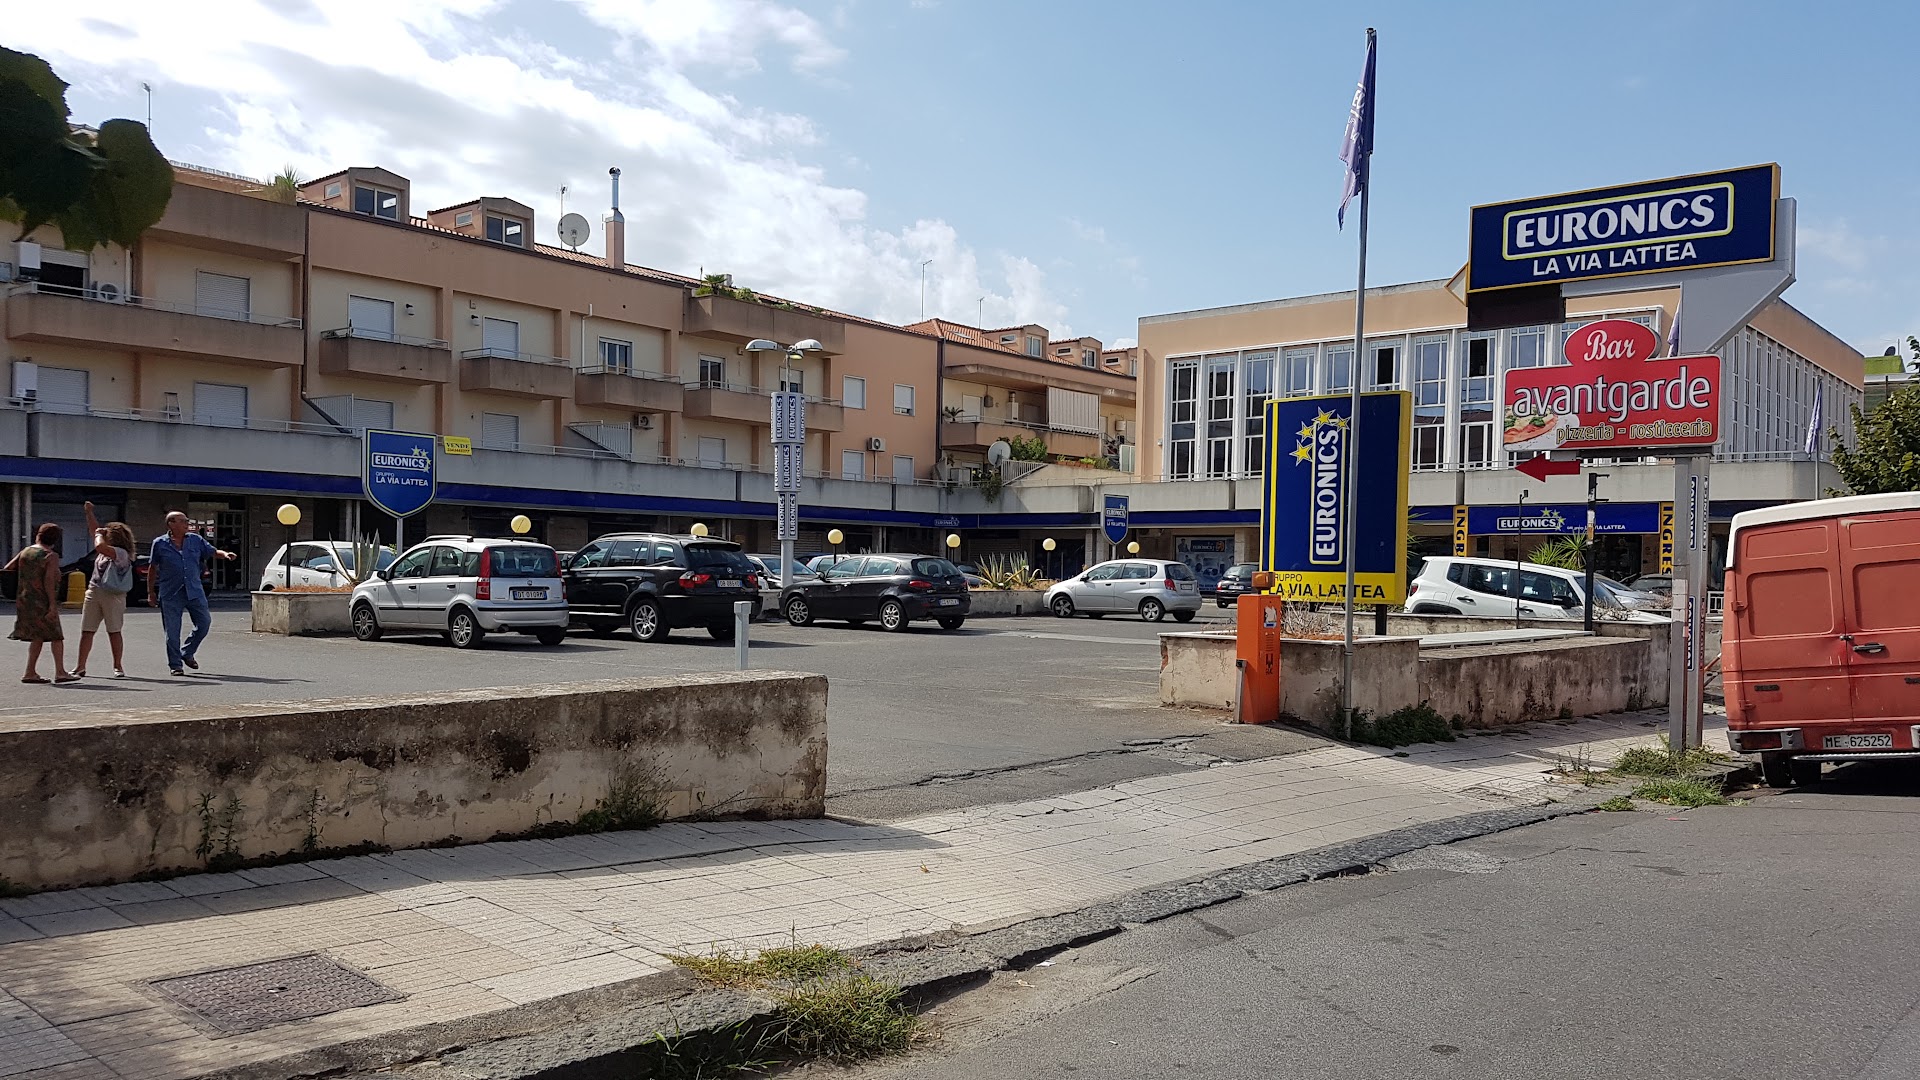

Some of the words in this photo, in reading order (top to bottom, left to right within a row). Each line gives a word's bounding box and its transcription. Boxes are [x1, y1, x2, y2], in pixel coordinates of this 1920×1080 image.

[1516, 194, 1715, 249] EURONICS
[1533, 256, 1560, 276] LA
[1566, 252, 1602, 272] VIA
[1609, 241, 1697, 268] LATTEA
[1583, 329, 1636, 362] Bar
[1512, 366, 1712, 423] avantgarde
[1556, 422, 1615, 444] pizzeria
[1630, 418, 1713, 440] rosticceria
[375, 456, 424, 468] EURONICS
[401, 478, 428, 486] LATTEA
[1316, 430, 1339, 556] EURONICS
[1500, 519, 1556, 527] EURONICS
[1274, 574, 1302, 582] RUPPO
[1268, 584, 1284, 595] LA
[1289, 584, 1312, 597] VIA
[1826, 737, 1841, 747] ME
[1850, 735, 1891, 747] 625252
